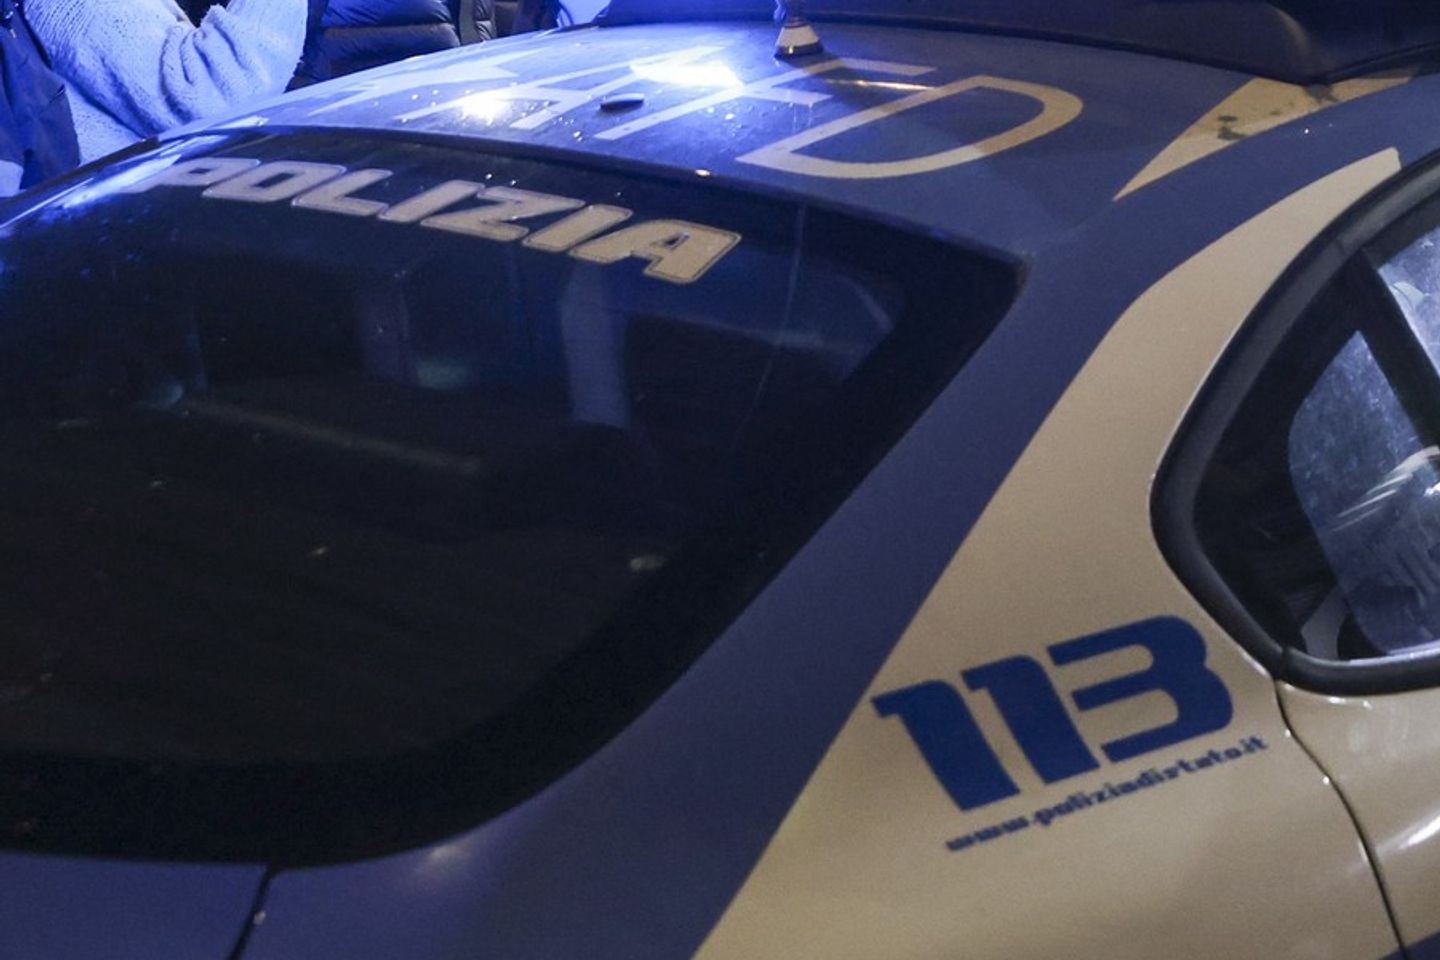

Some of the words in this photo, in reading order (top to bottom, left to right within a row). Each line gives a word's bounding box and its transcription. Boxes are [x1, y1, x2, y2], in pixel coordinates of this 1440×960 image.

[122, 156, 743, 285] POLIZIA
[869, 614, 1235, 812] 113
[945, 735, 1269, 852] www.poliziadistato.it
